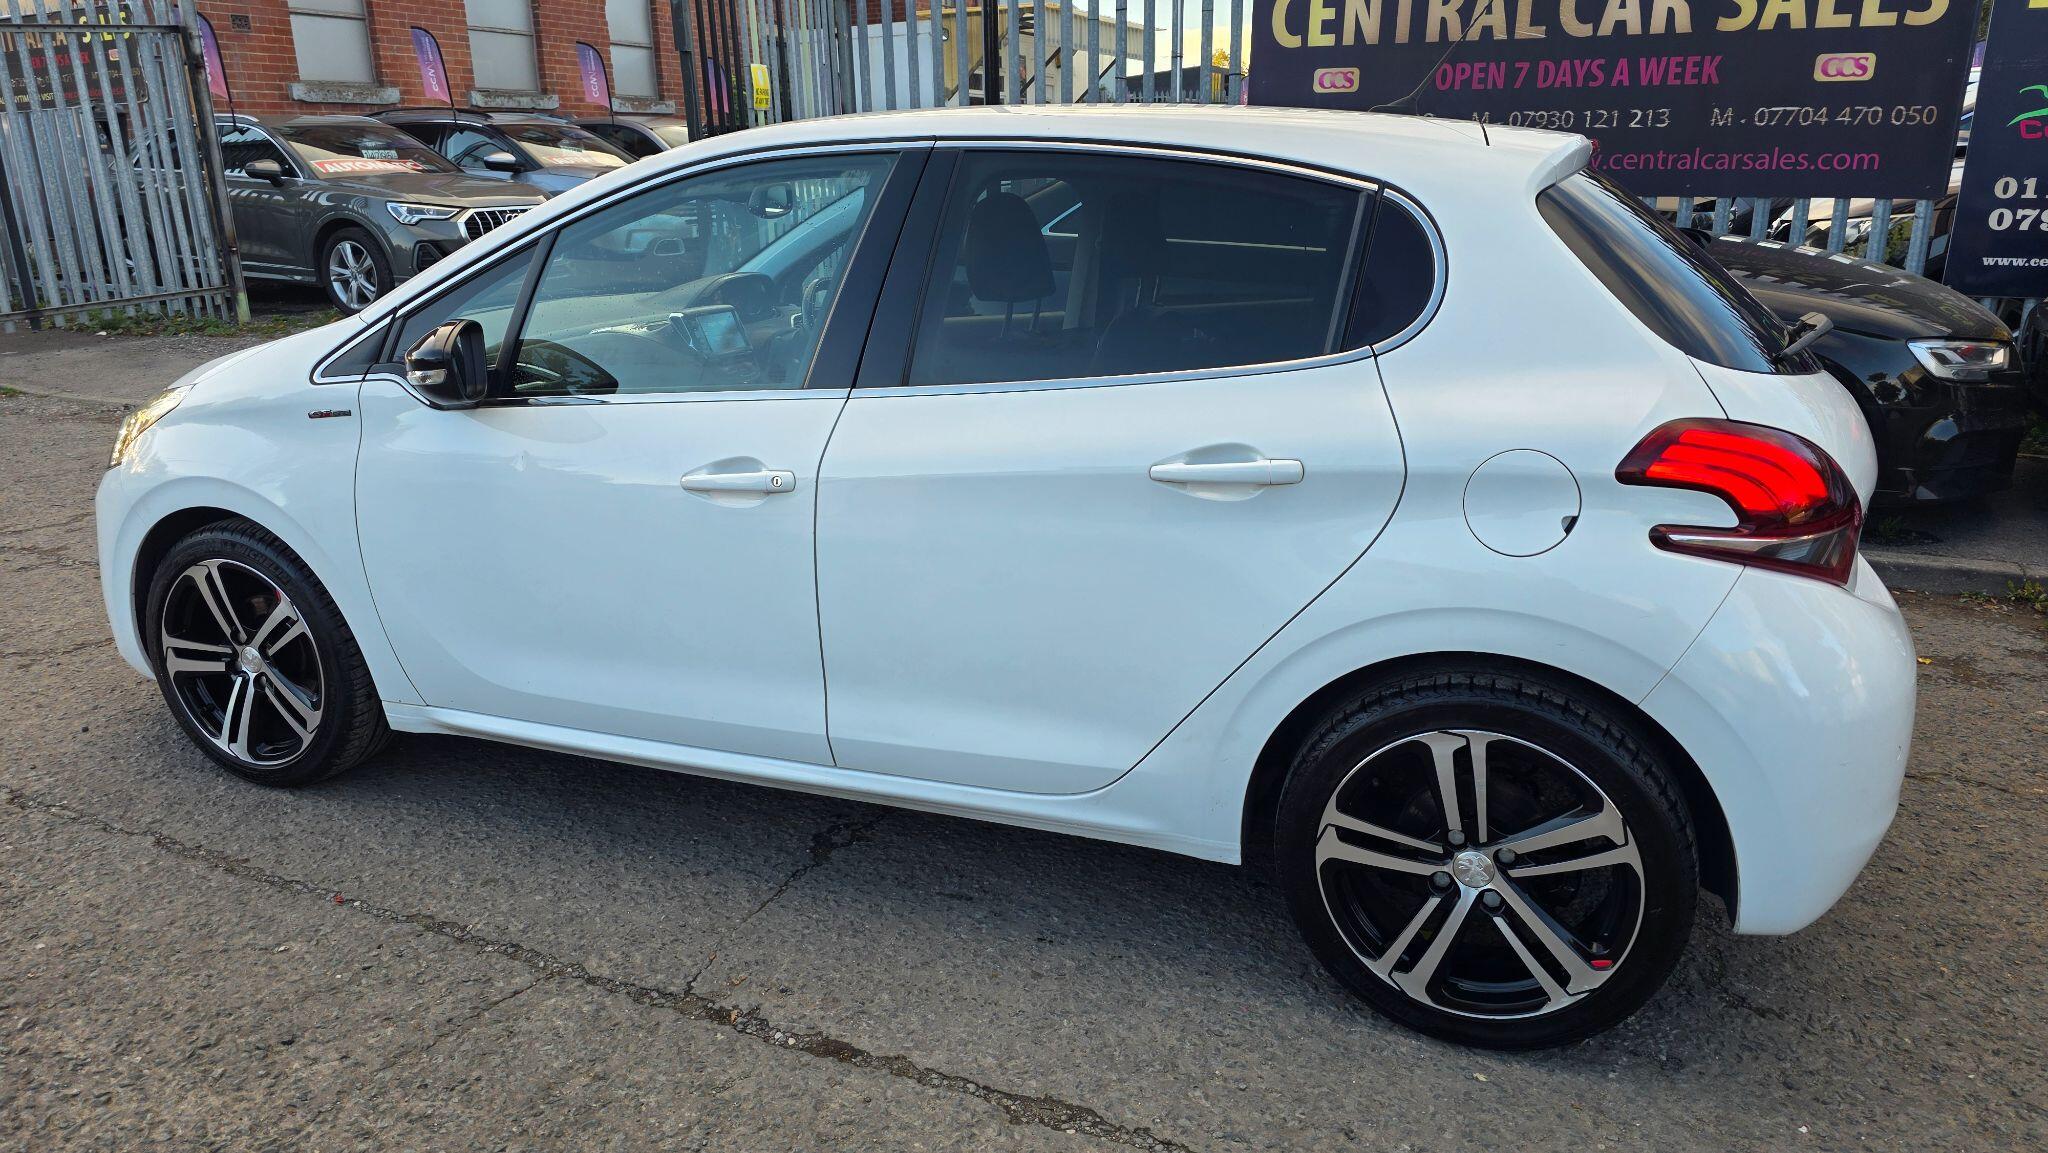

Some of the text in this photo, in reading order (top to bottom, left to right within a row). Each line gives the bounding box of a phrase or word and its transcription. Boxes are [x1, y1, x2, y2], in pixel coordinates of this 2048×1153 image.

[1715, 0, 1951, 33] SALES
[1435, 55, 1724, 91] OPEN 7 DAYS A WEEK
[1818, 55, 1871, 79] CCS
[1317, 70, 1356, 90] CCS
[1508, 110, 1575, 129] 07930
[1582, 110, 1619, 128] 121
[1628, 109, 1673, 128] 213
[1709, 107, 1734, 126] M
[1753, 106, 1830, 126] 07704
[1834, 106, 1883, 126] 470
[1889, 105, 1938, 126] 050
[1994, 176, 2048, 199] 01
